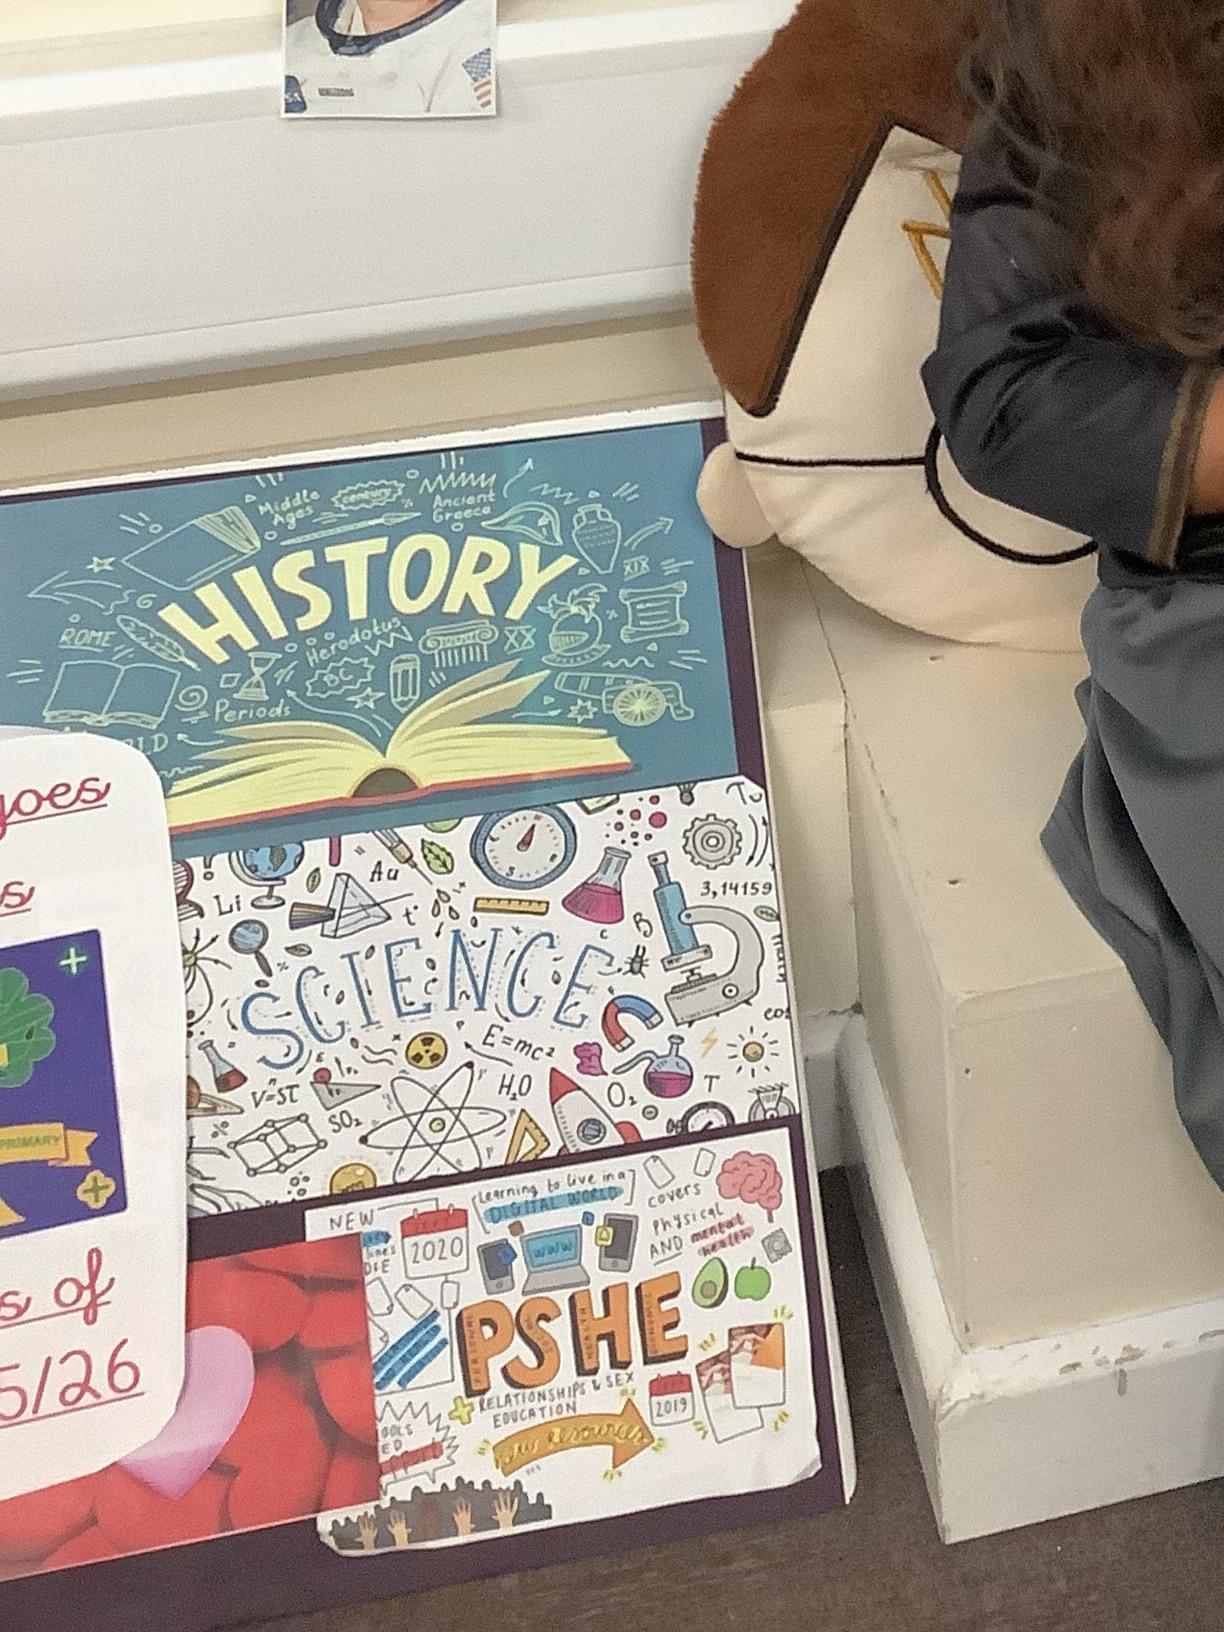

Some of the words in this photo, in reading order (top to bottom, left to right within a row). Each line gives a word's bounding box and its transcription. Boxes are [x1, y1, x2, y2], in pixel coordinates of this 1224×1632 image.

[258, 489, 320, 516] Middle
[342, 487, 393, 505] century
[432, 490, 496, 510] Ancient
[272, 505, 315, 530] Ages
[432, 505, 493, 524] Greece
[157, 533, 580, 666] HISTORY
[59, 627, 117, 648] ROME
[306, 615, 402, 667] Herodotus
[326, 671, 354, 688] BC
[214, 699, 292, 722] Periods
[369, 860, 400, 883] Au
[699, 881, 774, 900] 3,14159
[213, 894, 243, 917] Li
[240, 926, 616, 1070] SCIENCE
[479, 1184, 538, 1204] Learning
[547, 1179, 560, 1192] to
[567, 1173, 596, 1187] live
[648, 1183, 701, 1208] covers
[330, 1209, 374, 1230] NEW
[411, 1236, 463, 1264] 2020
[650, 1235, 683, 1259] AND
[54, 1247, 115, 1325] of
[456, 1271, 688, 1398] PSHE
[0, 1338, 140, 1420] 5/26
[479, 1383, 587, 1412] RELATIONSHIPS
[592, 1379, 600, 1391] &
[606, 1372, 634, 1388] SEX
[492, 1402, 577, 1429] EDUCATION
[656, 1398, 688, 1417] 2019
